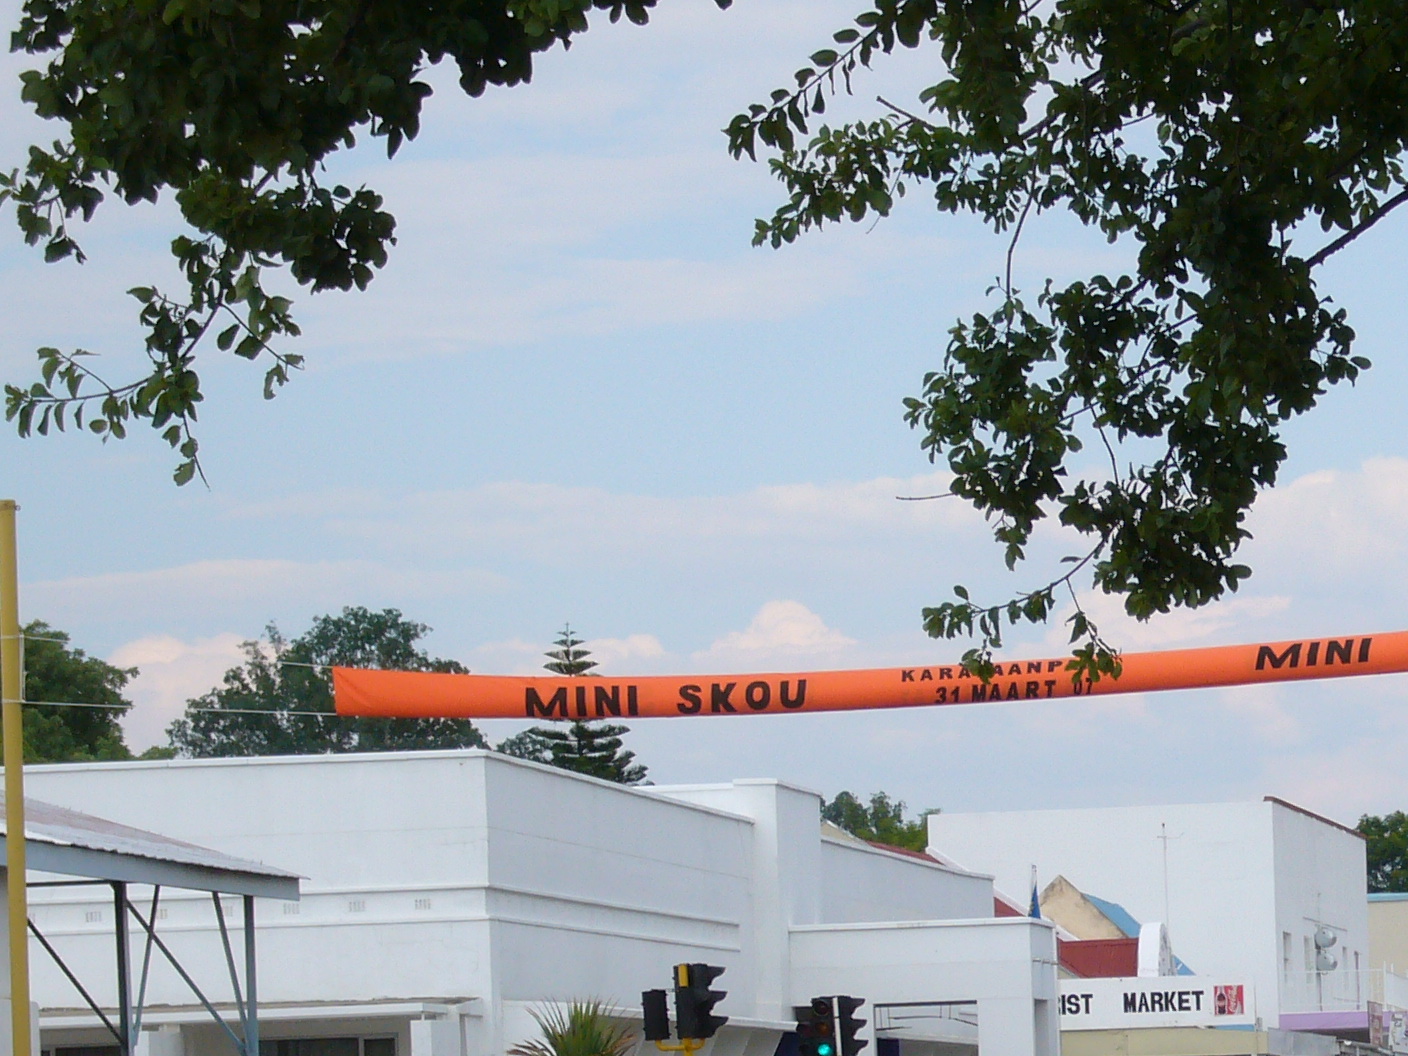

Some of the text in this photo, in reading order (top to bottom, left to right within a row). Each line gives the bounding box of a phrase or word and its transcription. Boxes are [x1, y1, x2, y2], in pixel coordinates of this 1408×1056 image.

[1254, 636, 1374, 671] MINI
[524, 679, 808, 720] MINI SKOU
[934, 685, 961, 705] 31
[971, 679, 1057, 703] MAART
[1123, 990, 1204, 1013] MARKET
